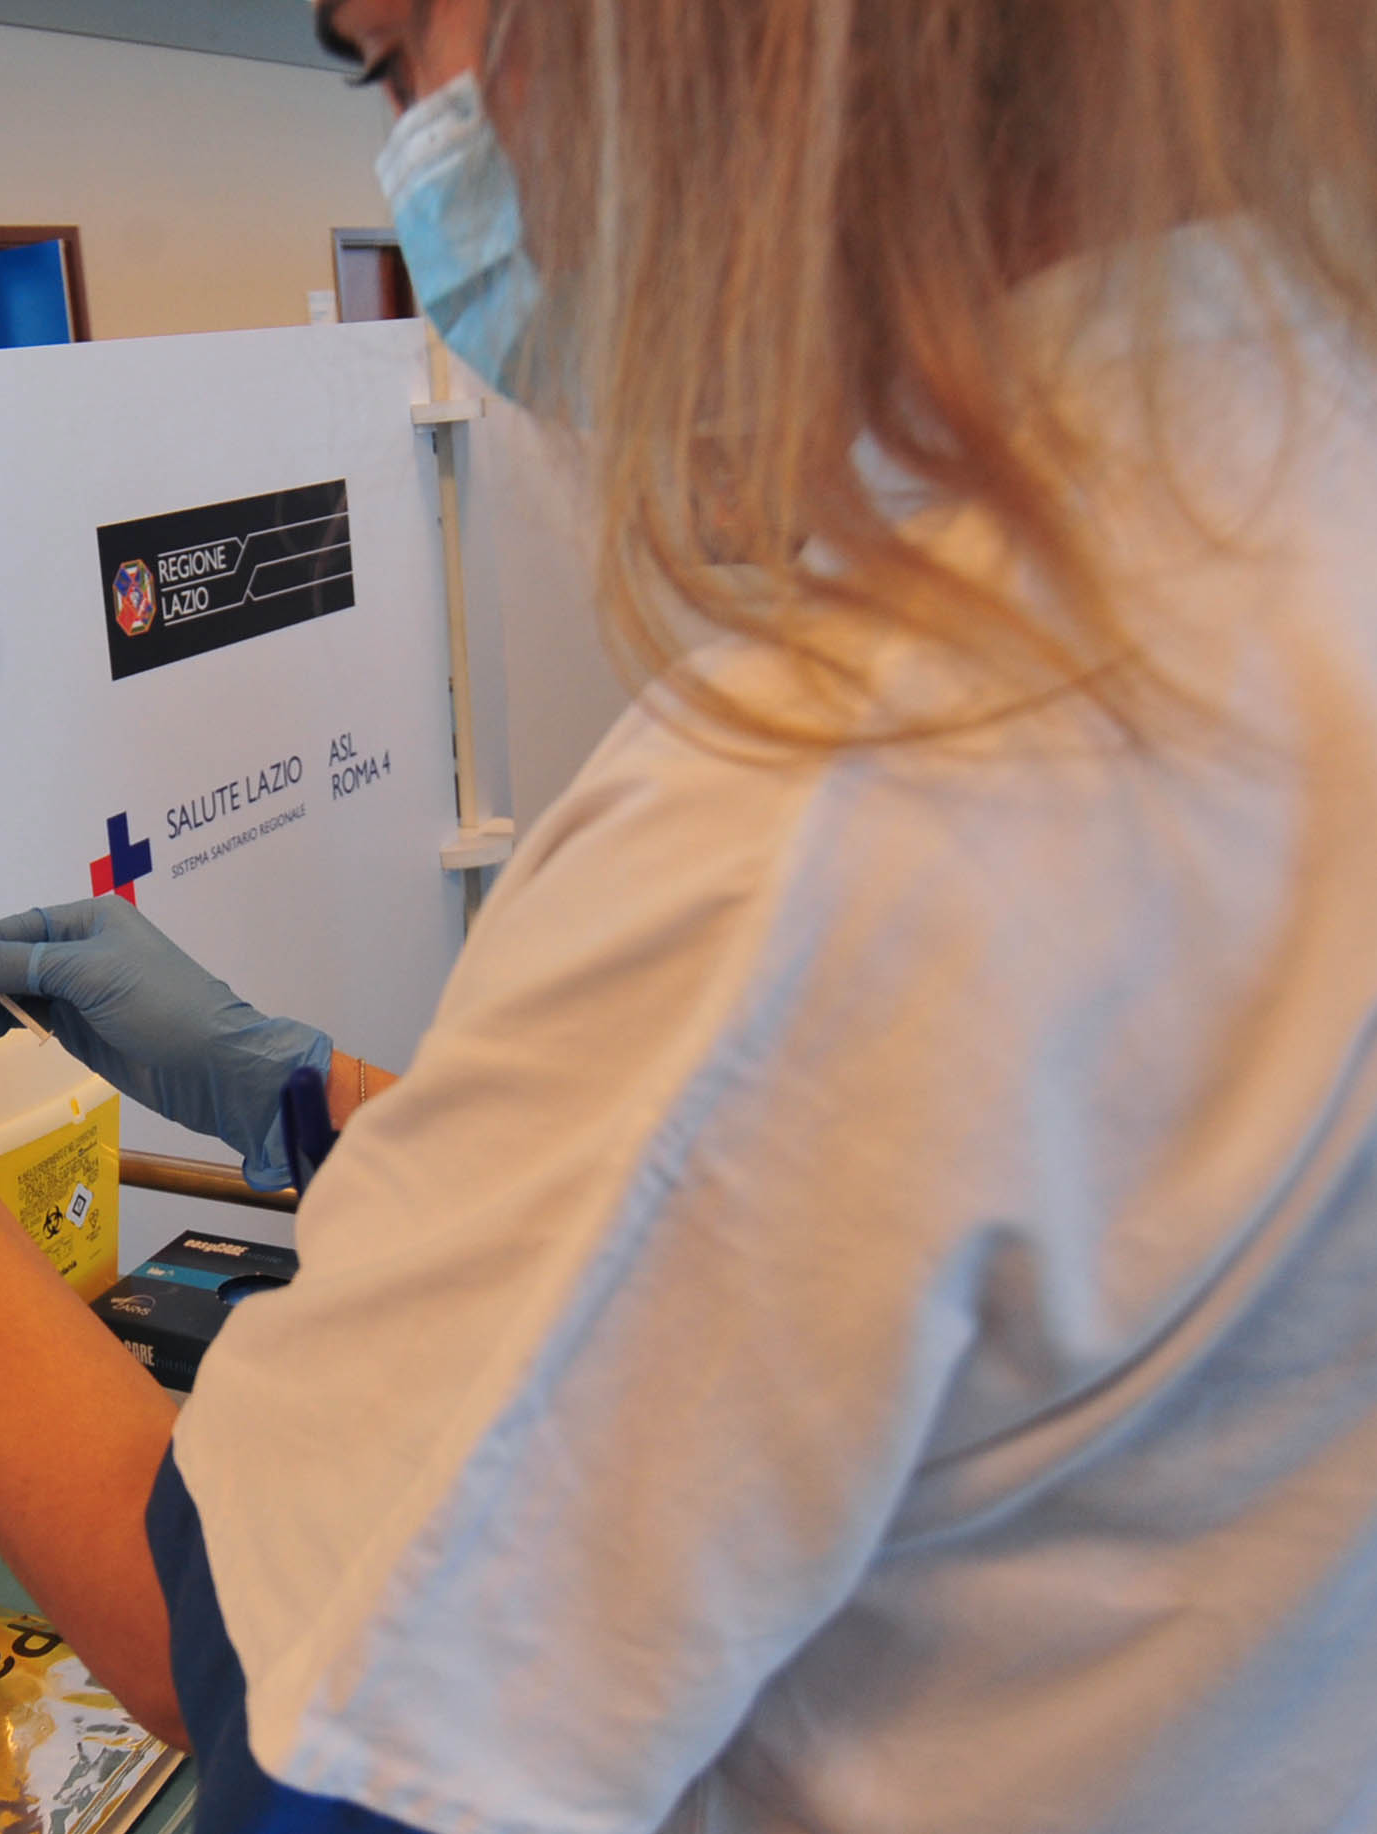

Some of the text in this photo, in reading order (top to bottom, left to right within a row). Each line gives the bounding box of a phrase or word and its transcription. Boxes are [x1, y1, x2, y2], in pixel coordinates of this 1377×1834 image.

[158, 545, 227, 584] REGIONE
[161, 586, 209, 620] LAZIO
[328, 732, 358, 767] ASL
[166, 755, 303, 839] SALUTE LAZIO
[331, 749, 392, 801] ROMA 4
[171, 801, 307, 880] SISTEMA SANITARIO REGIONALE
